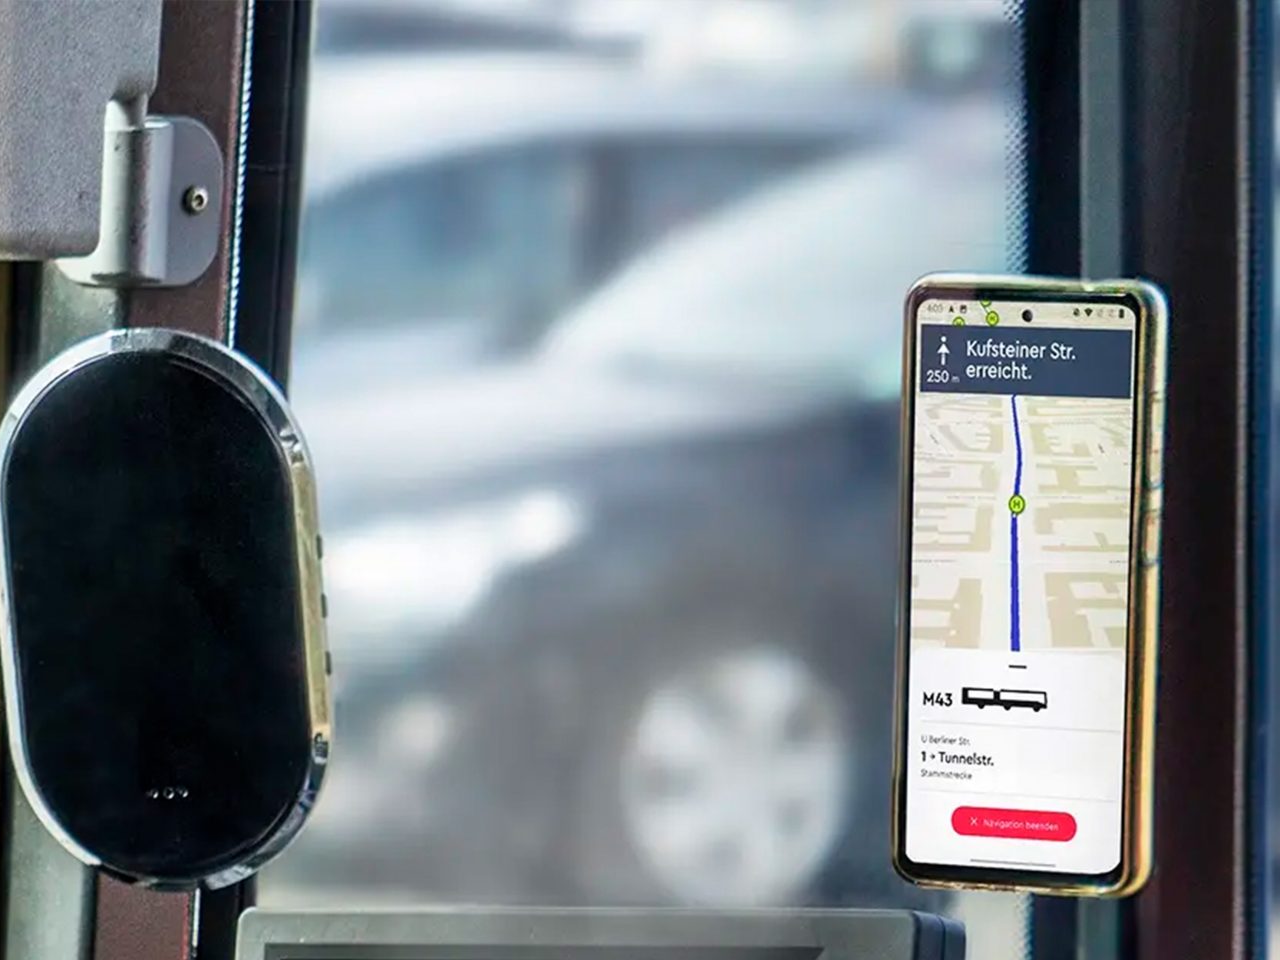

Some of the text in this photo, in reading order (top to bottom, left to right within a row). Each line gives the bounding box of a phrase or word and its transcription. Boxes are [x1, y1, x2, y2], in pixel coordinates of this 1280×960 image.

[966, 338, 1076, 360] Kufsteiner Str.
[926, 369, 950, 384] 250
[965, 361, 1032, 380] erreicht.
[923, 692, 953, 706] M43
[921, 751, 994, 767] 1 Tunnelstr.
